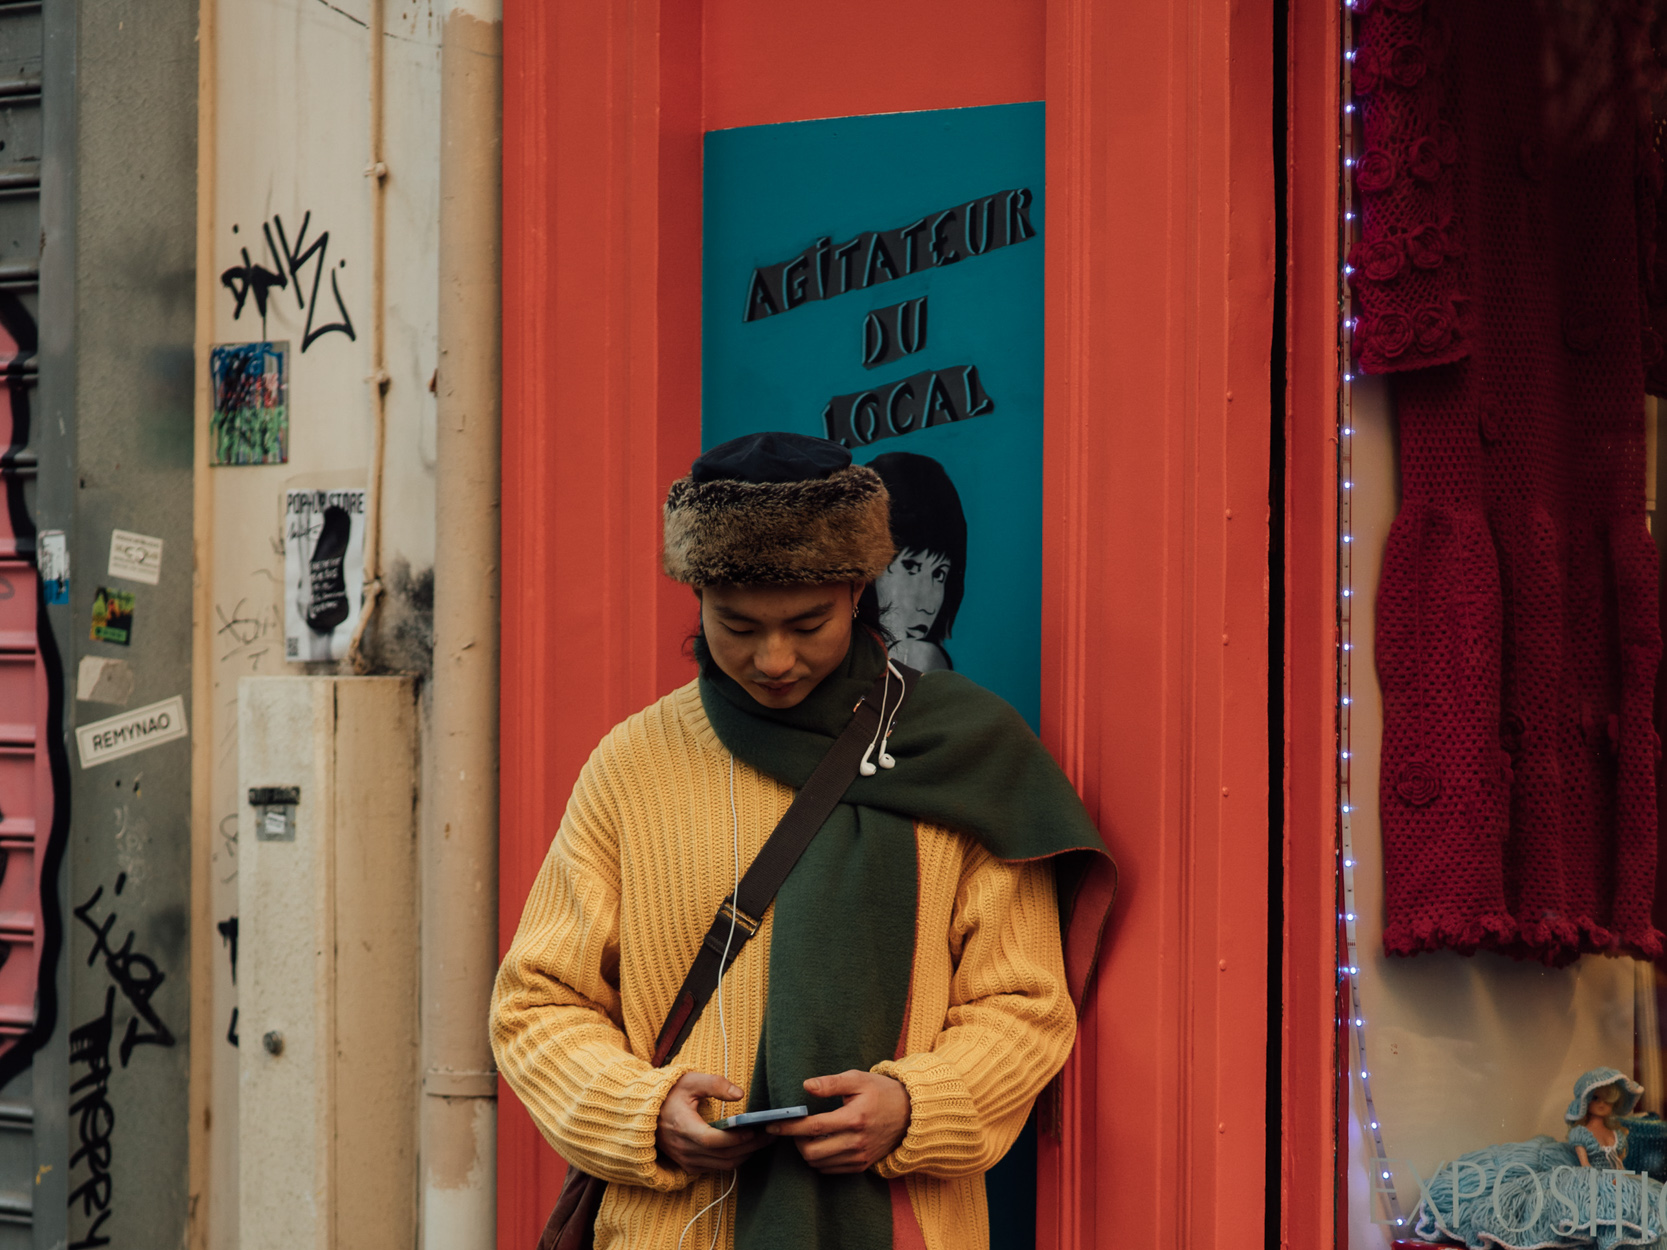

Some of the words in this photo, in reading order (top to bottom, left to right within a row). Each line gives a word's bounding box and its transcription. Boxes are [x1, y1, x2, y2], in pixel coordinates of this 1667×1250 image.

[861, 295, 929, 370] DU
[821, 364, 995, 449] LOCAL
[92, 712, 170, 752] REMYNAO
[1369, 1157, 1667, 1242] EXPOSITI
